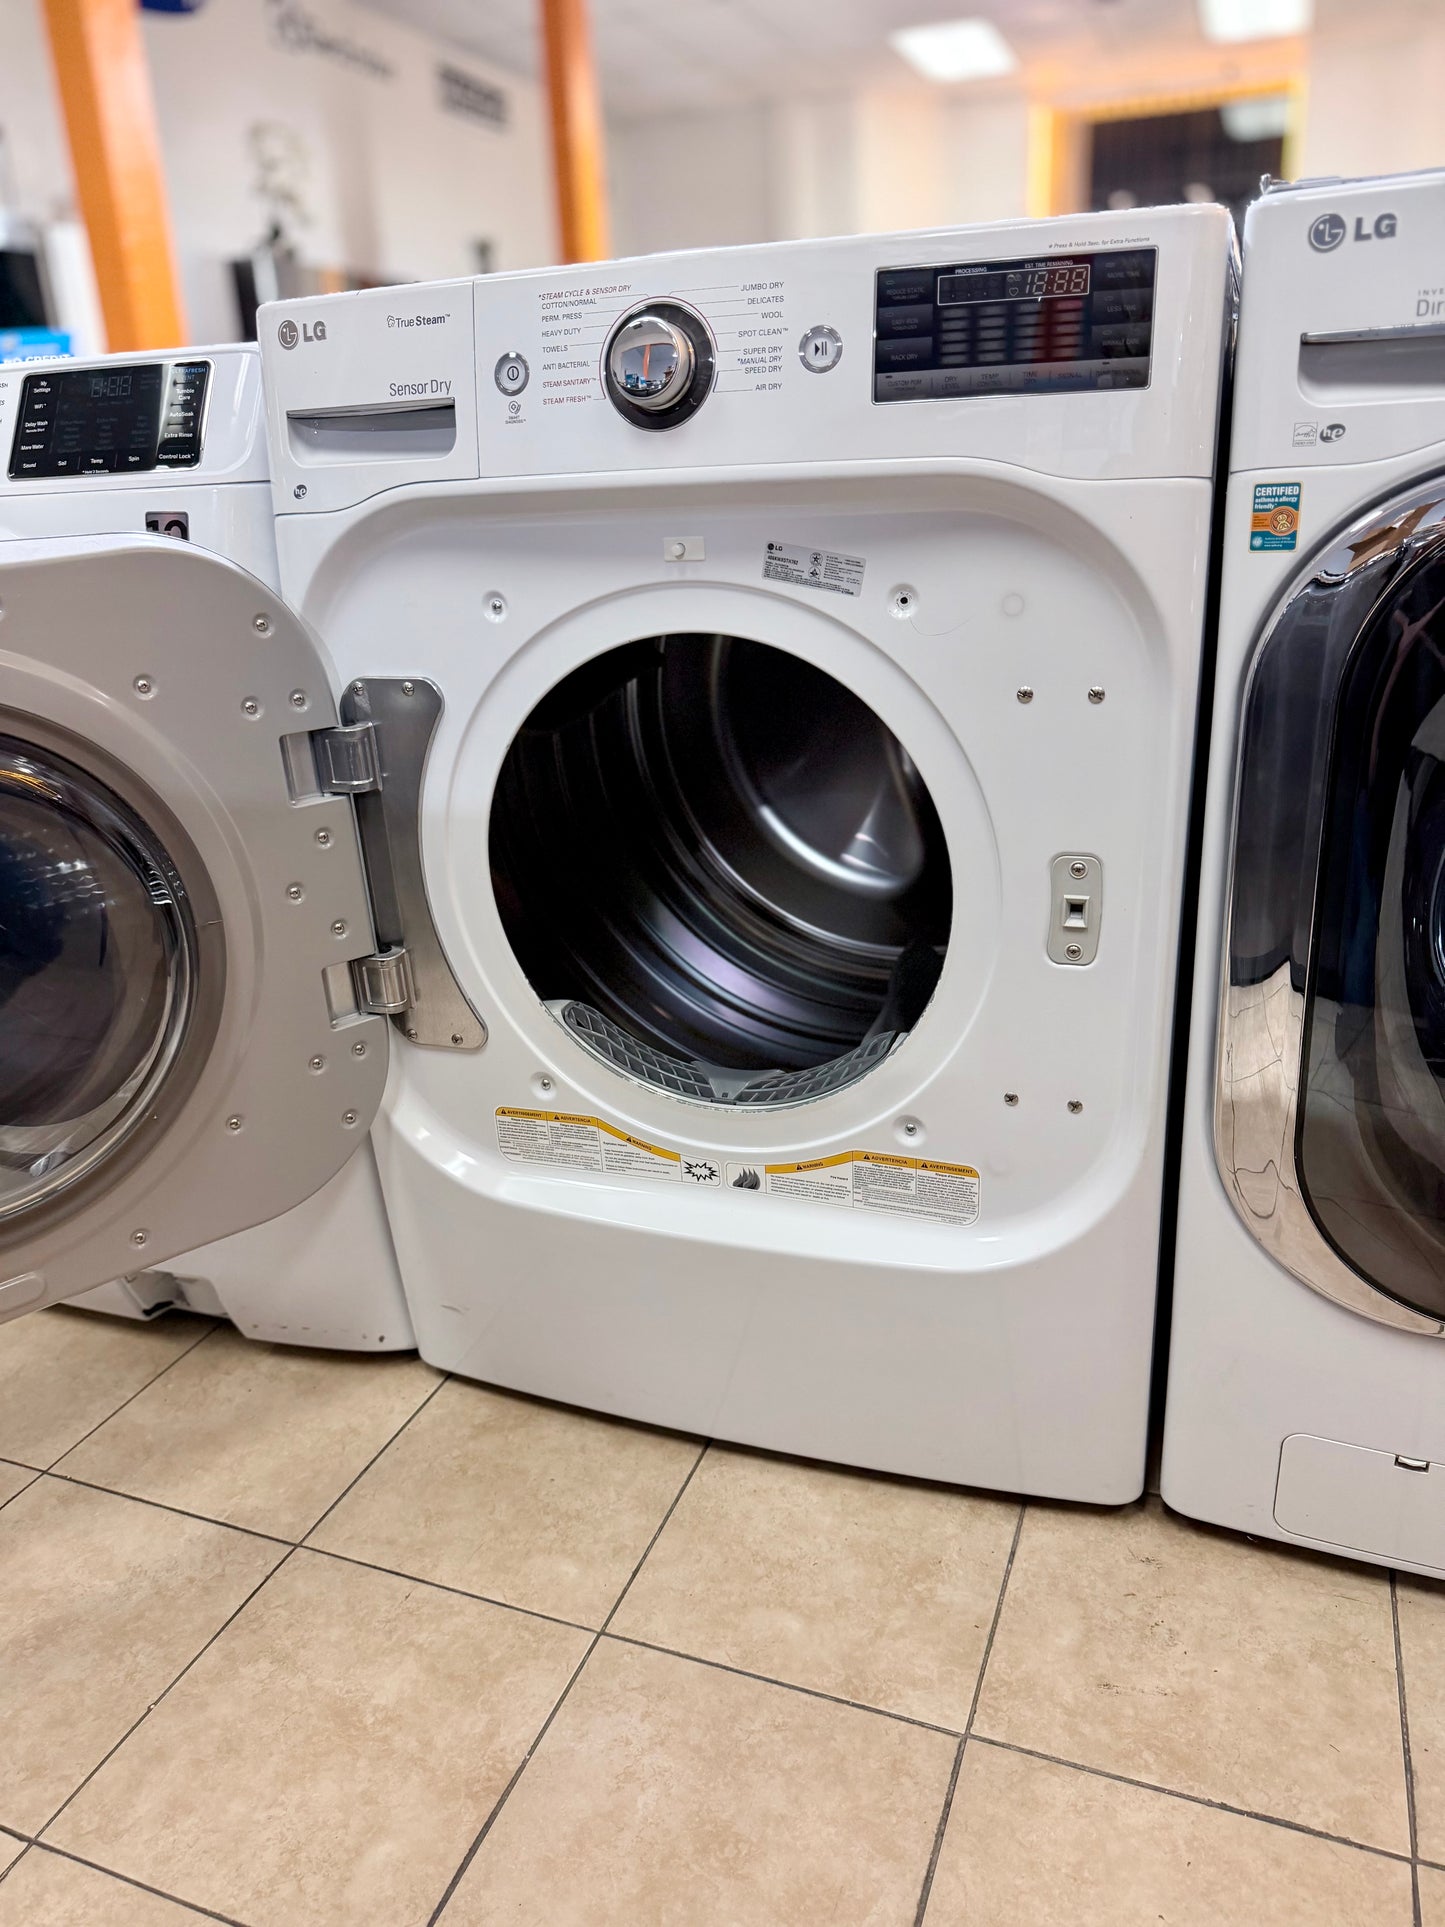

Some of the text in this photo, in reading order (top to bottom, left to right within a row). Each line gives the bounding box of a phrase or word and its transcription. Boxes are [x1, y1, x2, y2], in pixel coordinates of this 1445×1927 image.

[1354, 213, 1397, 242] LG
[955, 266, 988, 275] PROCESSING
[564, 289, 584, 298] CYCLE
[585, 288, 590, 296] &
[591, 286, 617, 296] SENSOR
[618, 284, 632, 293] DRY
[740, 281, 784, 292] JUMBO DRY
[747, 295, 785, 305] DELICATES
[541, 312, 583, 323] PERM. PRESS
[761, 311, 784, 319] WOOL
[302, 320, 327, 343] LG
[541, 327, 582, 338] HEAVY DUTY
[738, 329, 758, 338] SPOT
[542, 344, 568, 354] TOWELS
[743, 346, 783, 356] SUPER DRY
[768, 355, 783, 363] DRY
[907, 353, 919, 361] DRY
[542, 360, 591, 371] ANTI BACTERIAL
[744, 365, 783, 375] SPEED DRY
[40, 380, 48, 388] My
[389, 379, 452, 397] Sensor Dry
[542, 380, 562, 389] STEAM
[755, 382, 783, 391] AIR DRY
[542, 397, 565, 406] STEAM
[128, 455, 140, 463] Spin
[1255, 485, 1300, 497] CERTIFIED
[1279, 496, 1298, 504] allergy
[506, 1109, 543, 1118] AVERTISSEMENT
[560, 1115, 592, 1124] ADVERTENCIA
[632, 1139, 653, 1151] WARNING
[802, 1161, 824, 1169] WARNING
[871, 1155, 908, 1165] ADVERTENCIA
[929, 1163, 973, 1175] AVERTISSEMENT
